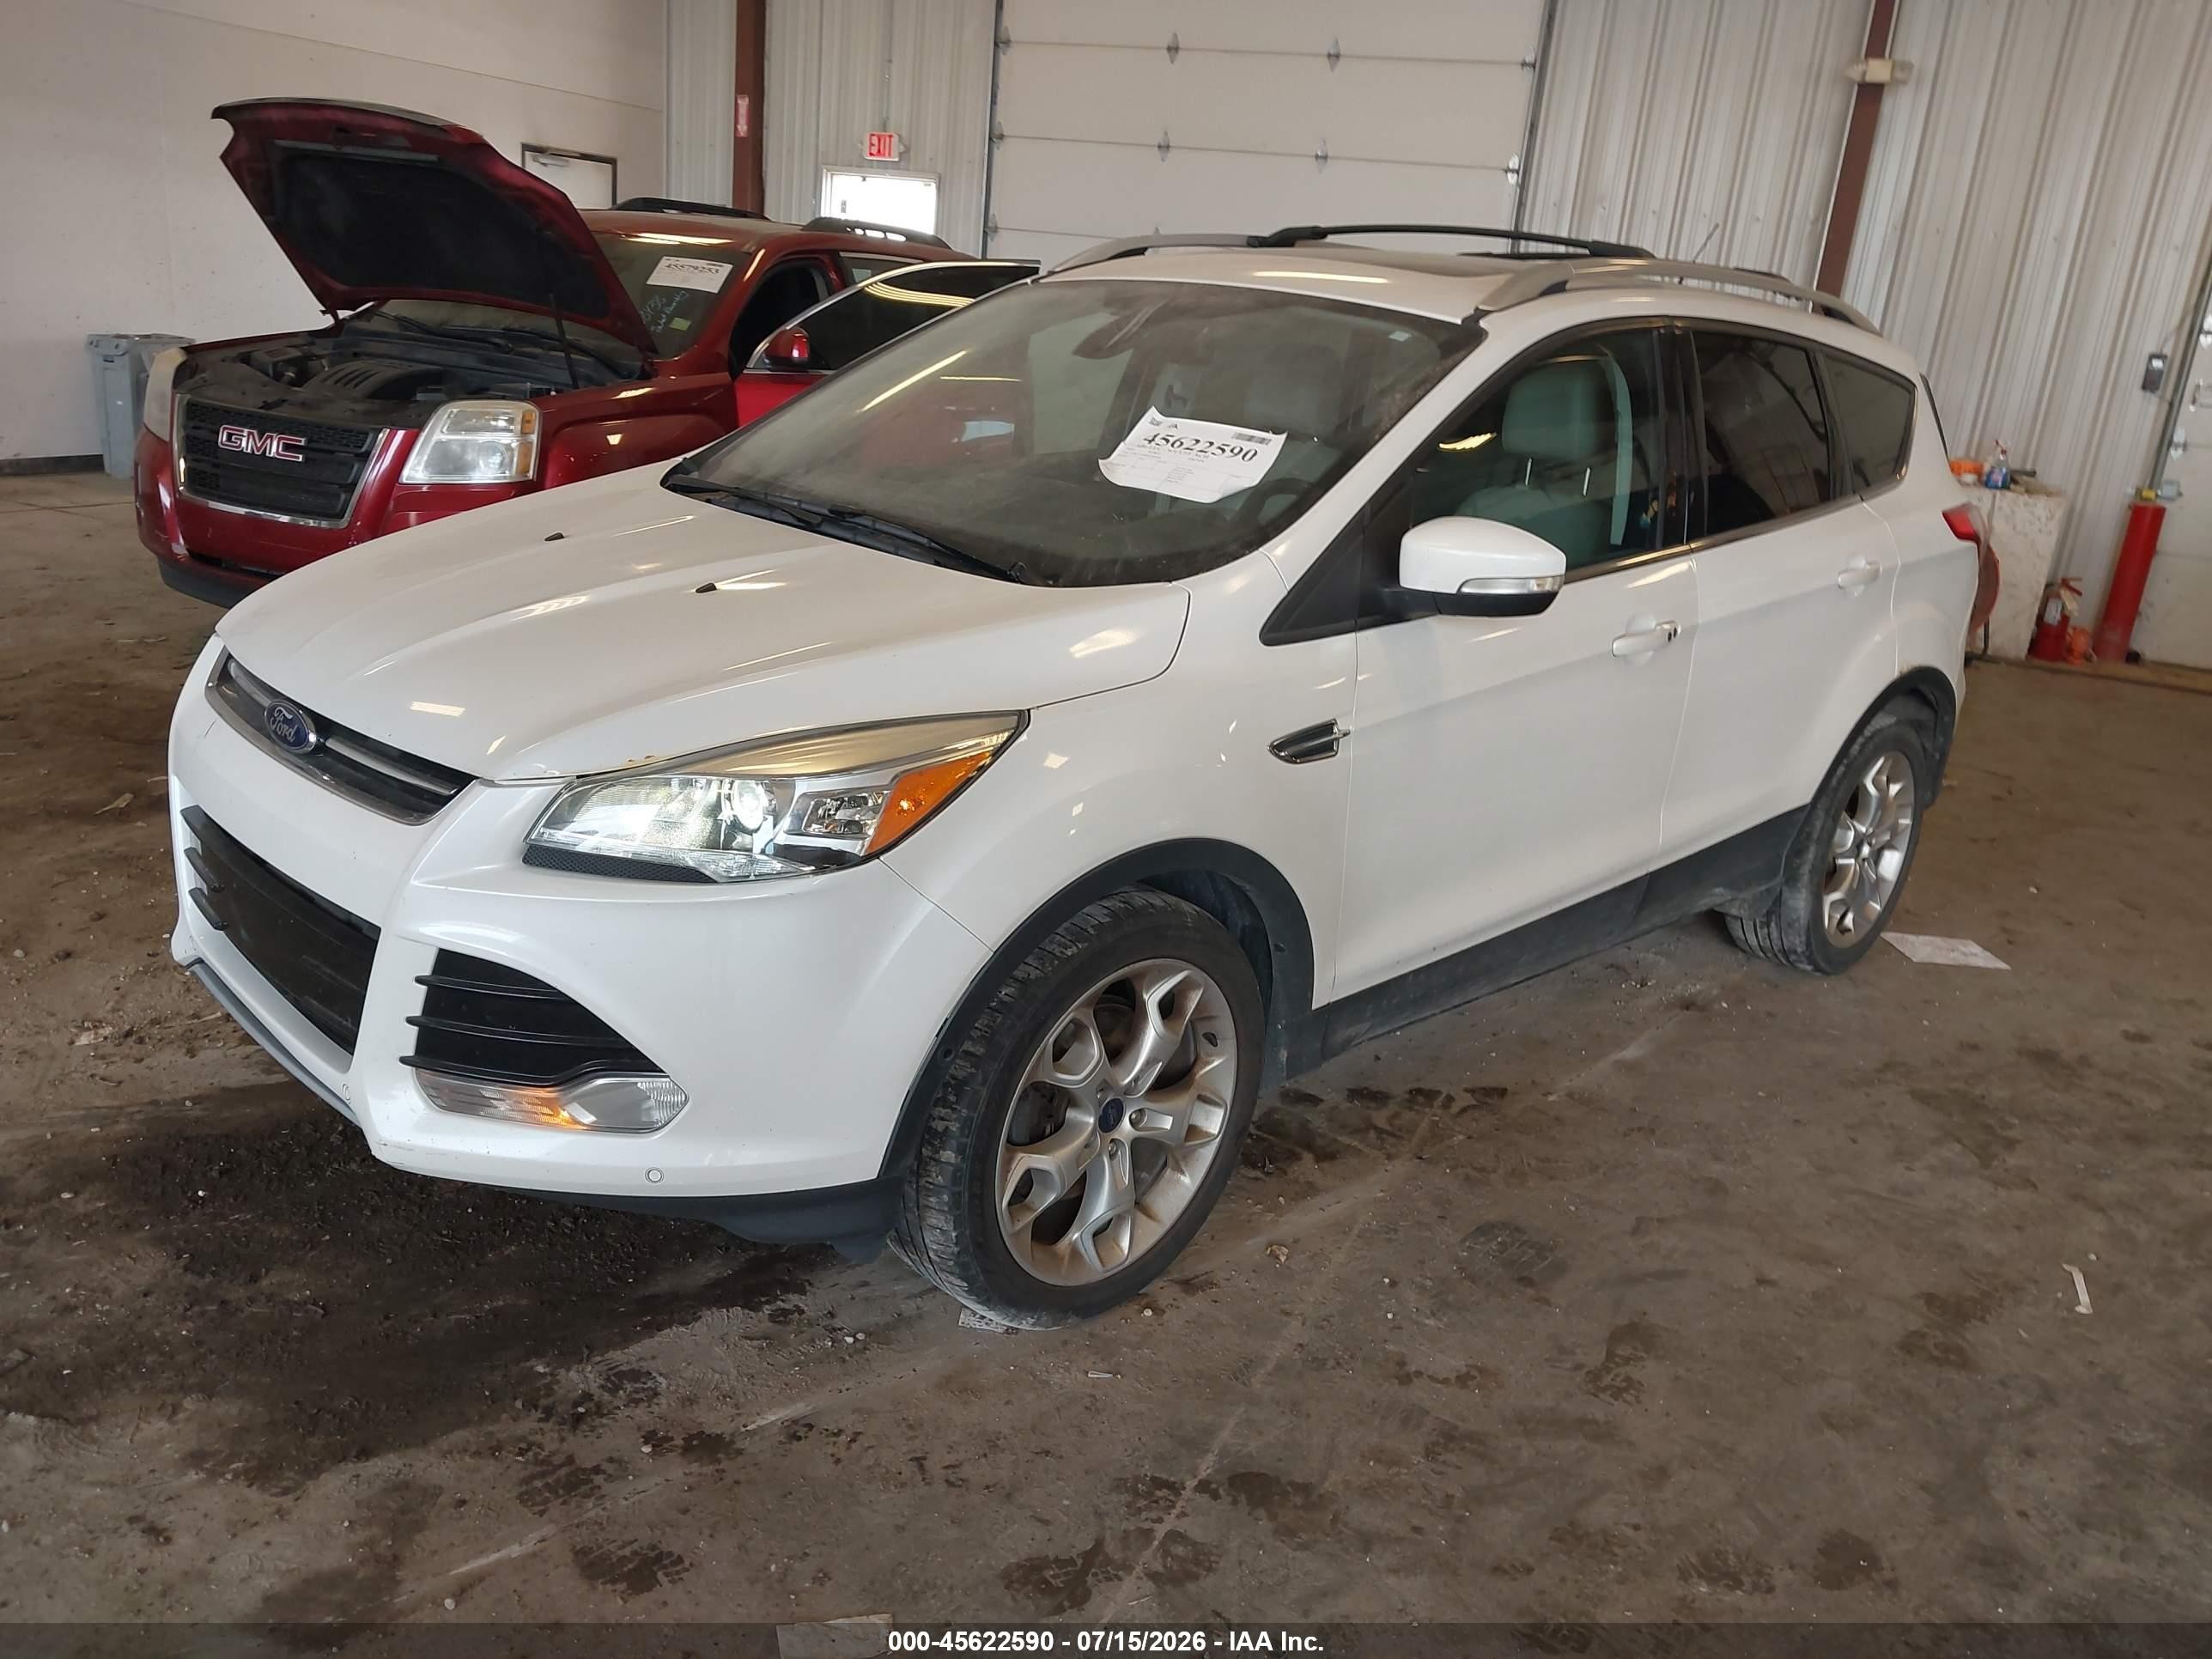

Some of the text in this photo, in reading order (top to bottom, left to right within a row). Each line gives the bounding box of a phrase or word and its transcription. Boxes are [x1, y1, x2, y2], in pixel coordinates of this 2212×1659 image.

[868, 133, 894, 157] EXIT
[218, 425, 305, 462] GMC
[1143, 432, 1258, 464] 45622590
[270, 707, 298, 743] Ford
